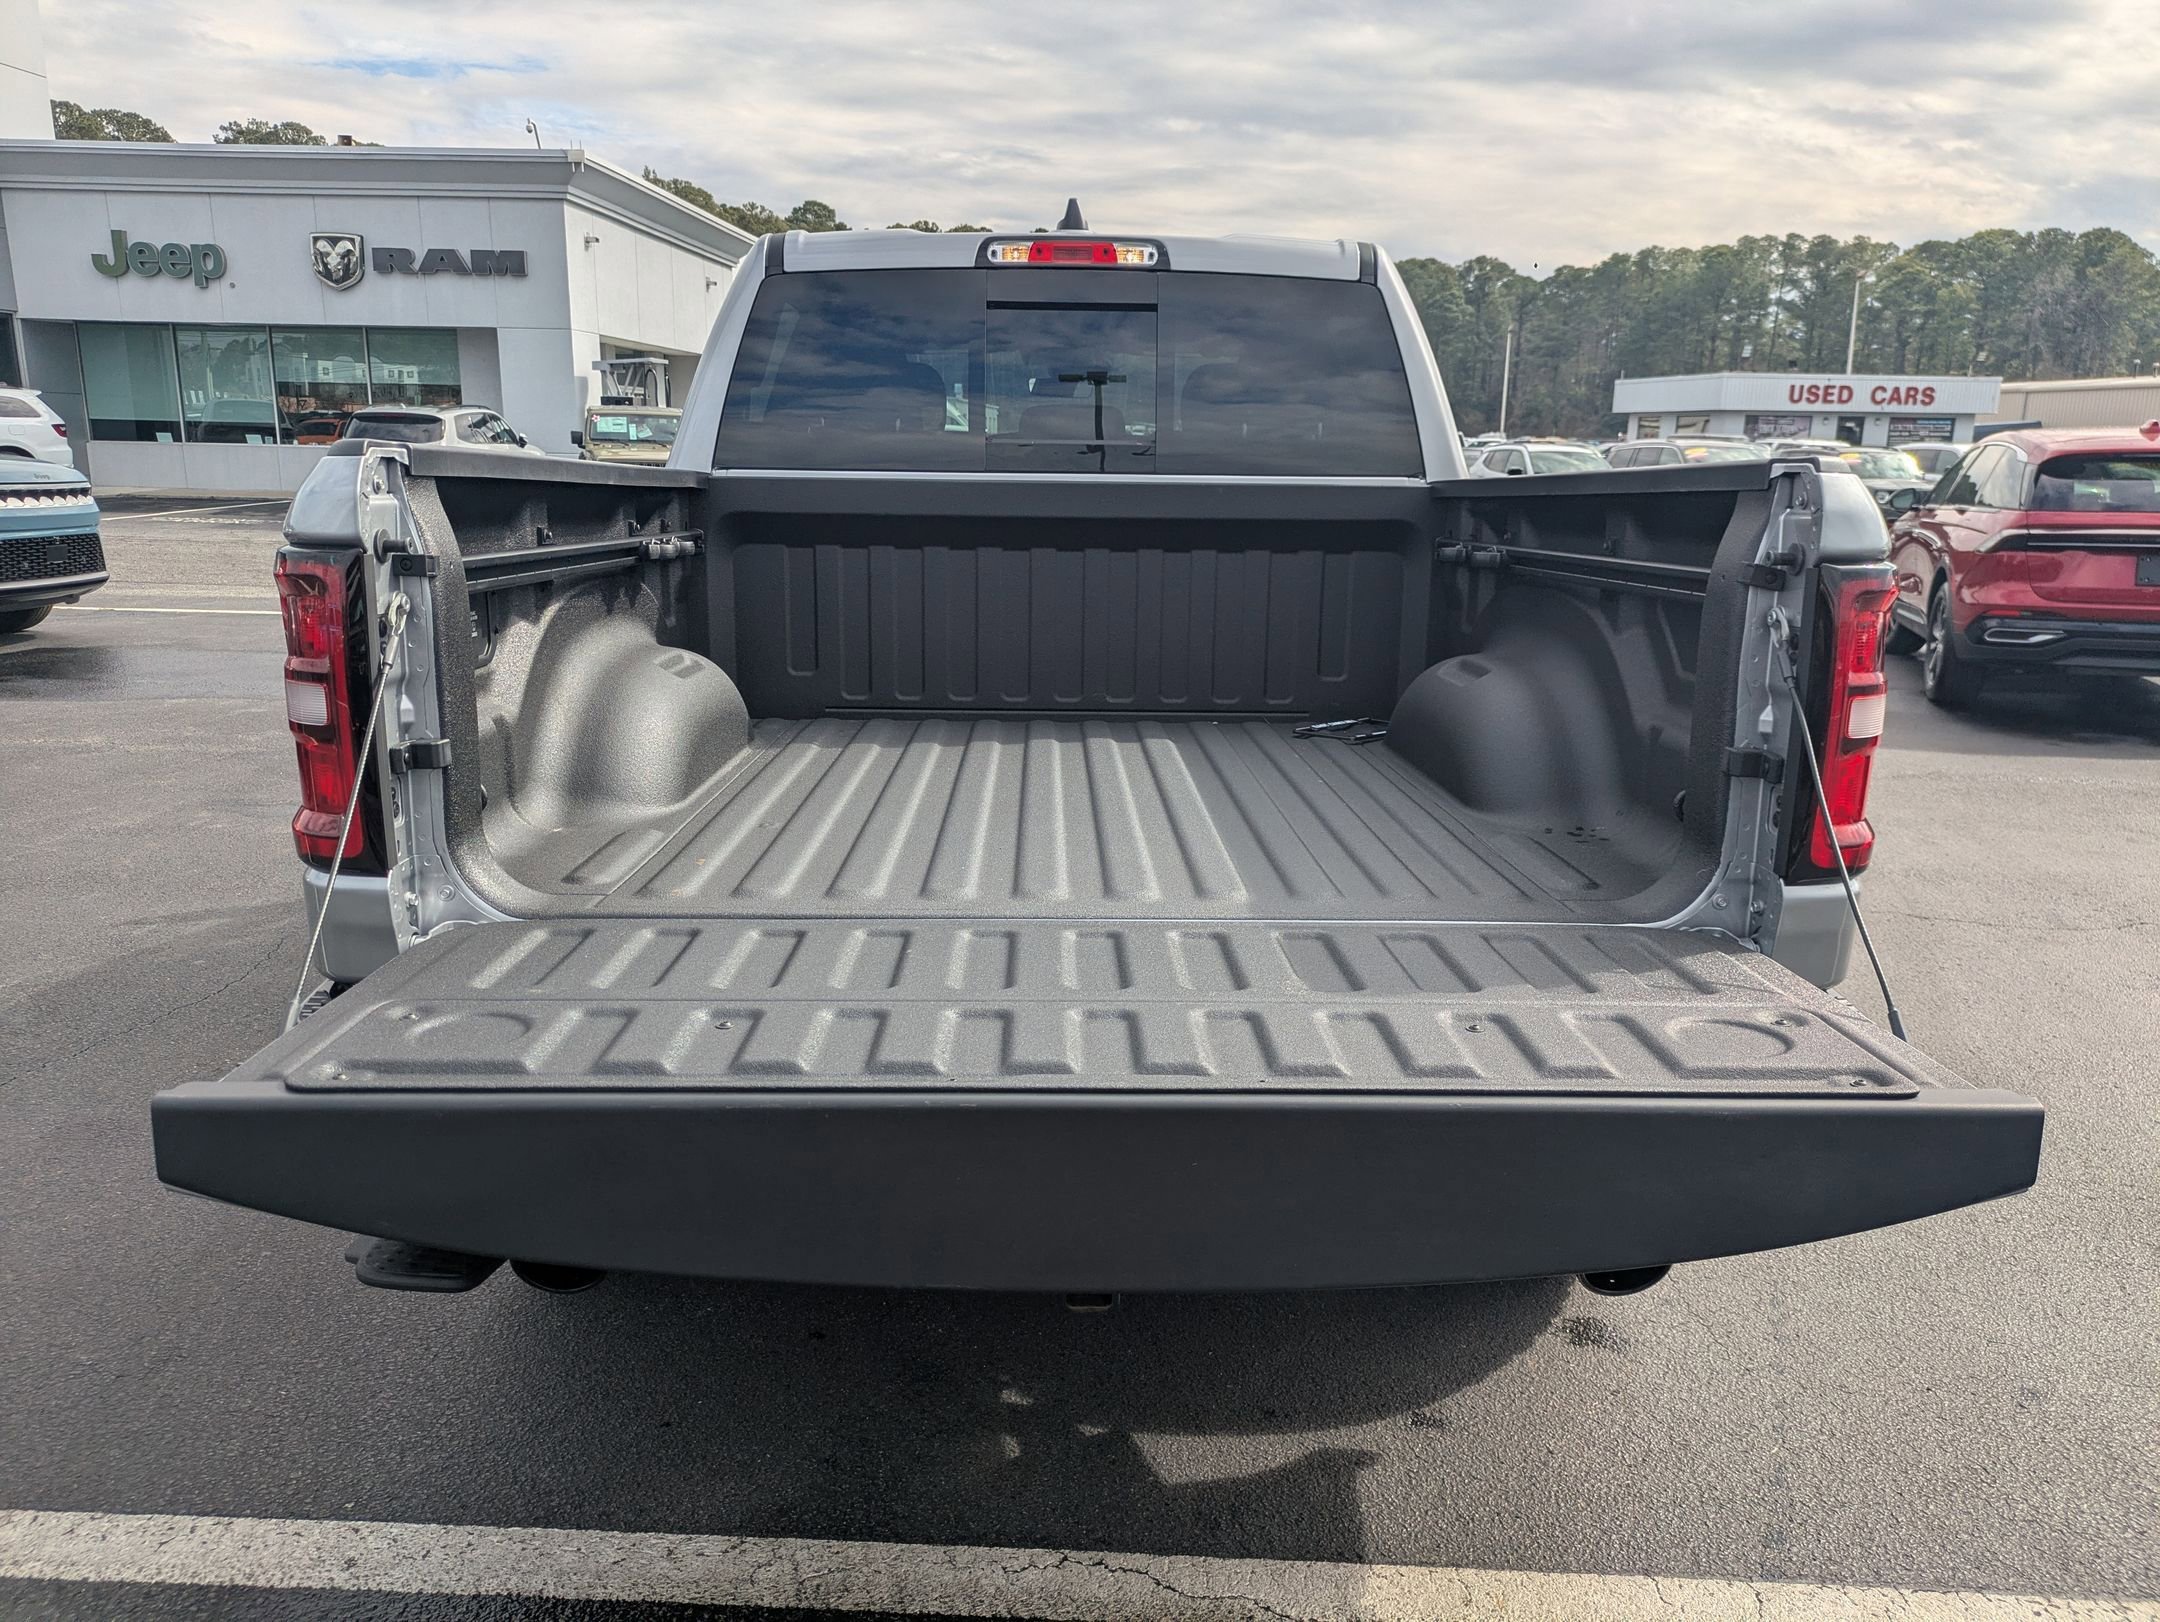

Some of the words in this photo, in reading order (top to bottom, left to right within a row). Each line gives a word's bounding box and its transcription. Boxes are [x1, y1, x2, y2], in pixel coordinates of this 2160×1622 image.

[91, 229, 227, 288] Jeep
[371, 247, 528, 277] RAM
[1788, 384, 1854, 404] USED
[1870, 385, 1936, 406] CARS
